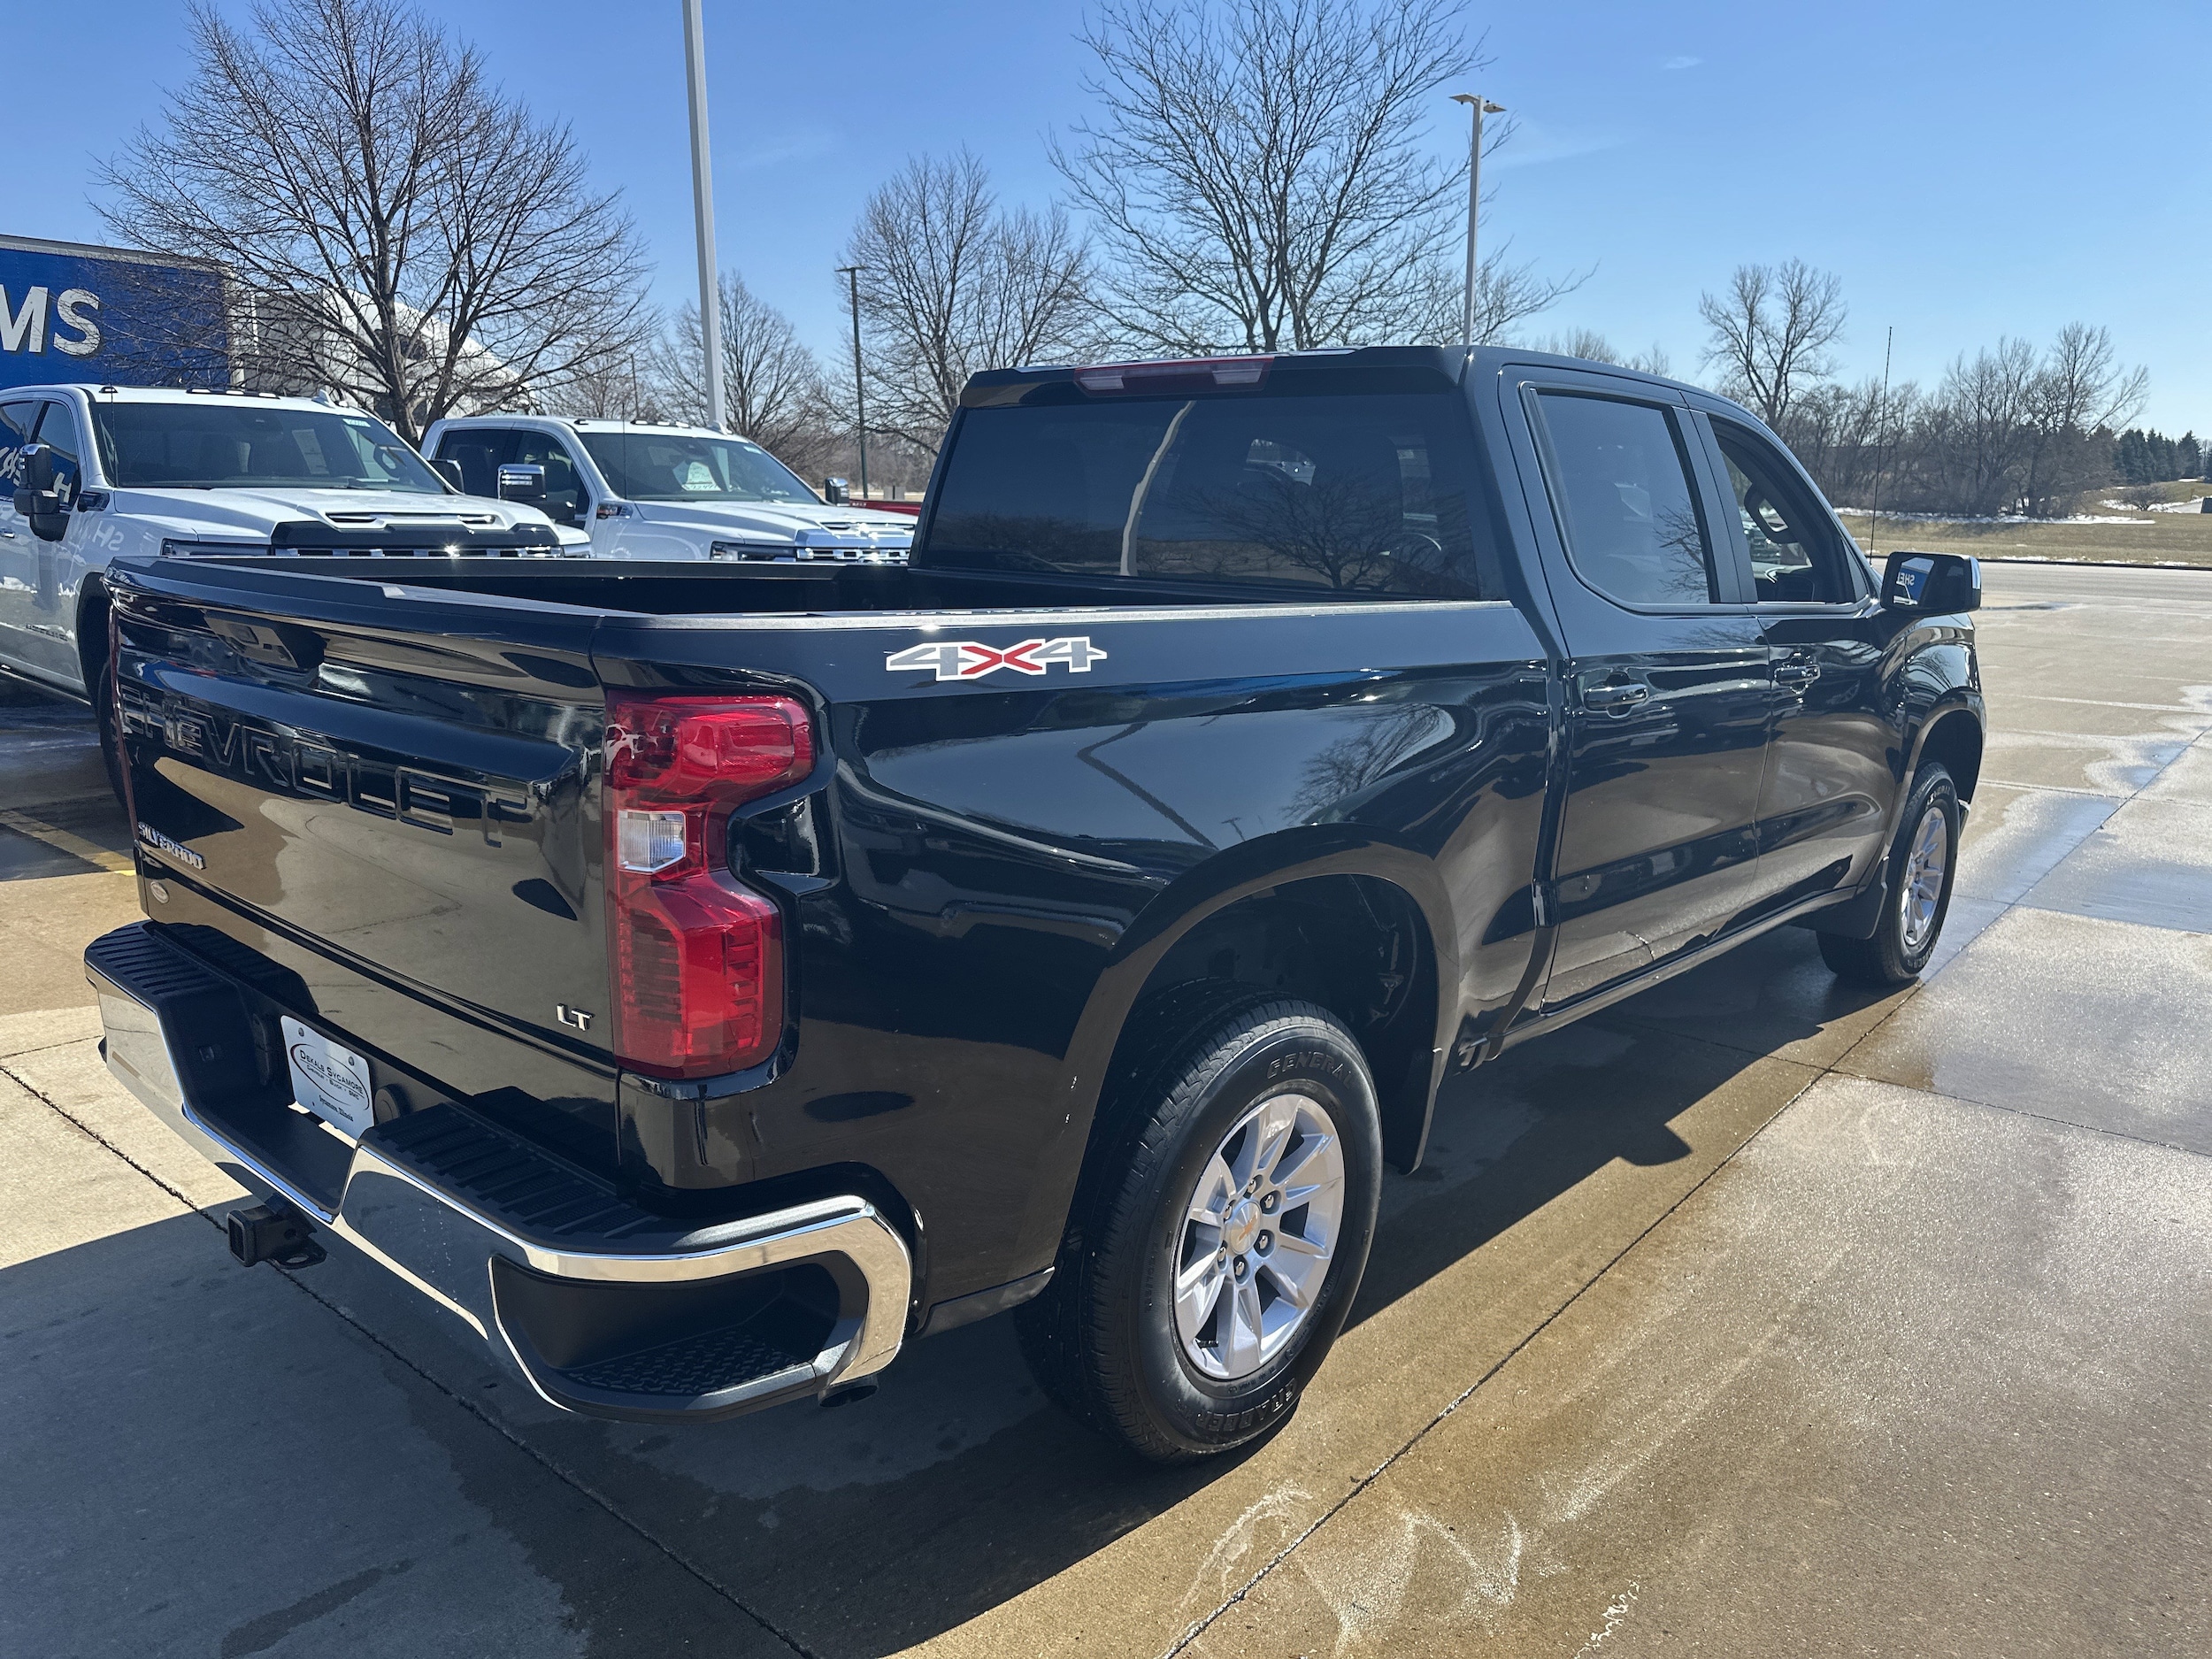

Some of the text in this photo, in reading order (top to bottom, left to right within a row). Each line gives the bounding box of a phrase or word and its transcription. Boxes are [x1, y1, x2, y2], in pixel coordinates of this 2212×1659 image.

[0, 284, 101, 356] MS
[120, 683, 528, 849] CHEVROLET
[138, 821, 205, 870] SILVERADO
[557, 1003, 593, 1032] LT
[1267, 1051, 1353, 1089] GENERAL
